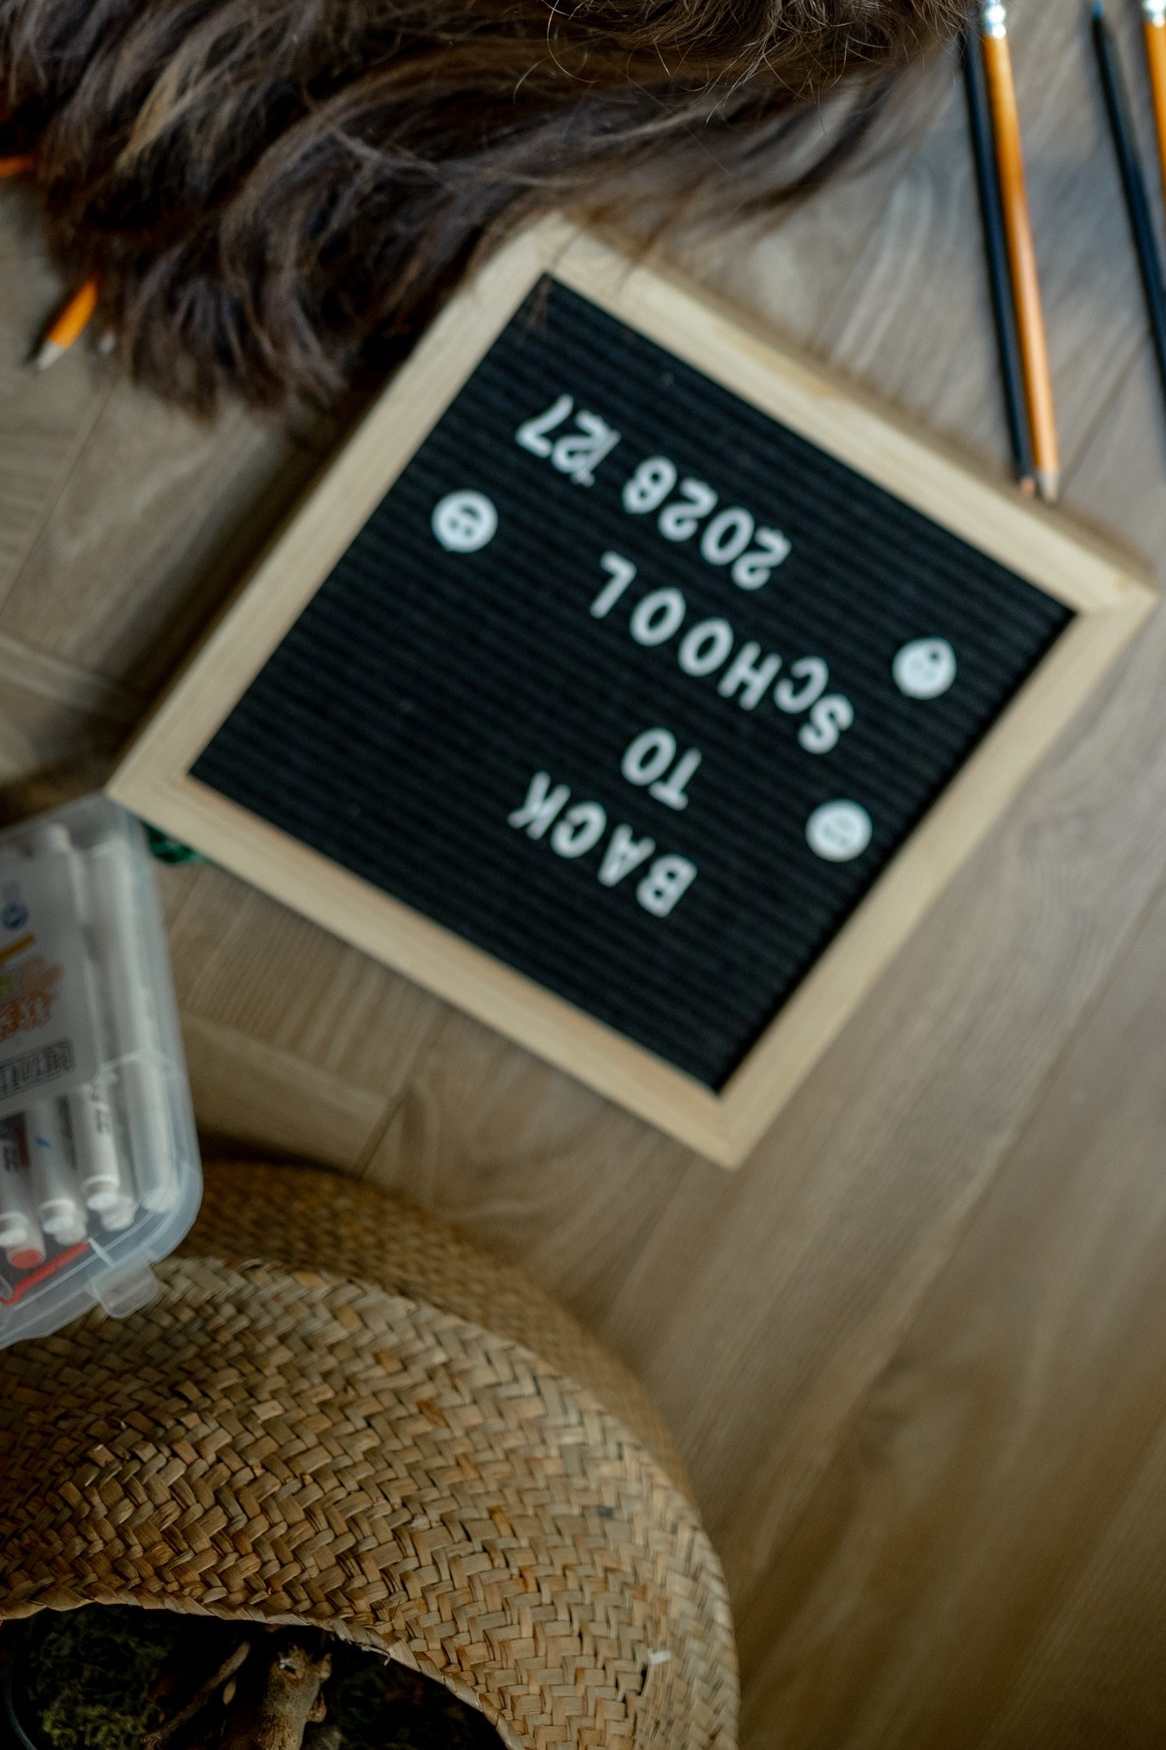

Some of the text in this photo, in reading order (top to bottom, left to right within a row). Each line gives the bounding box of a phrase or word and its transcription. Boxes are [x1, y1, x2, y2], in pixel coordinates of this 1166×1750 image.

[622, 455, 792, 591] 2026
[591, 551, 855, 755] SCHOOL
[622, 728, 702, 810] TO
[508, 771, 698, 917] BACK
